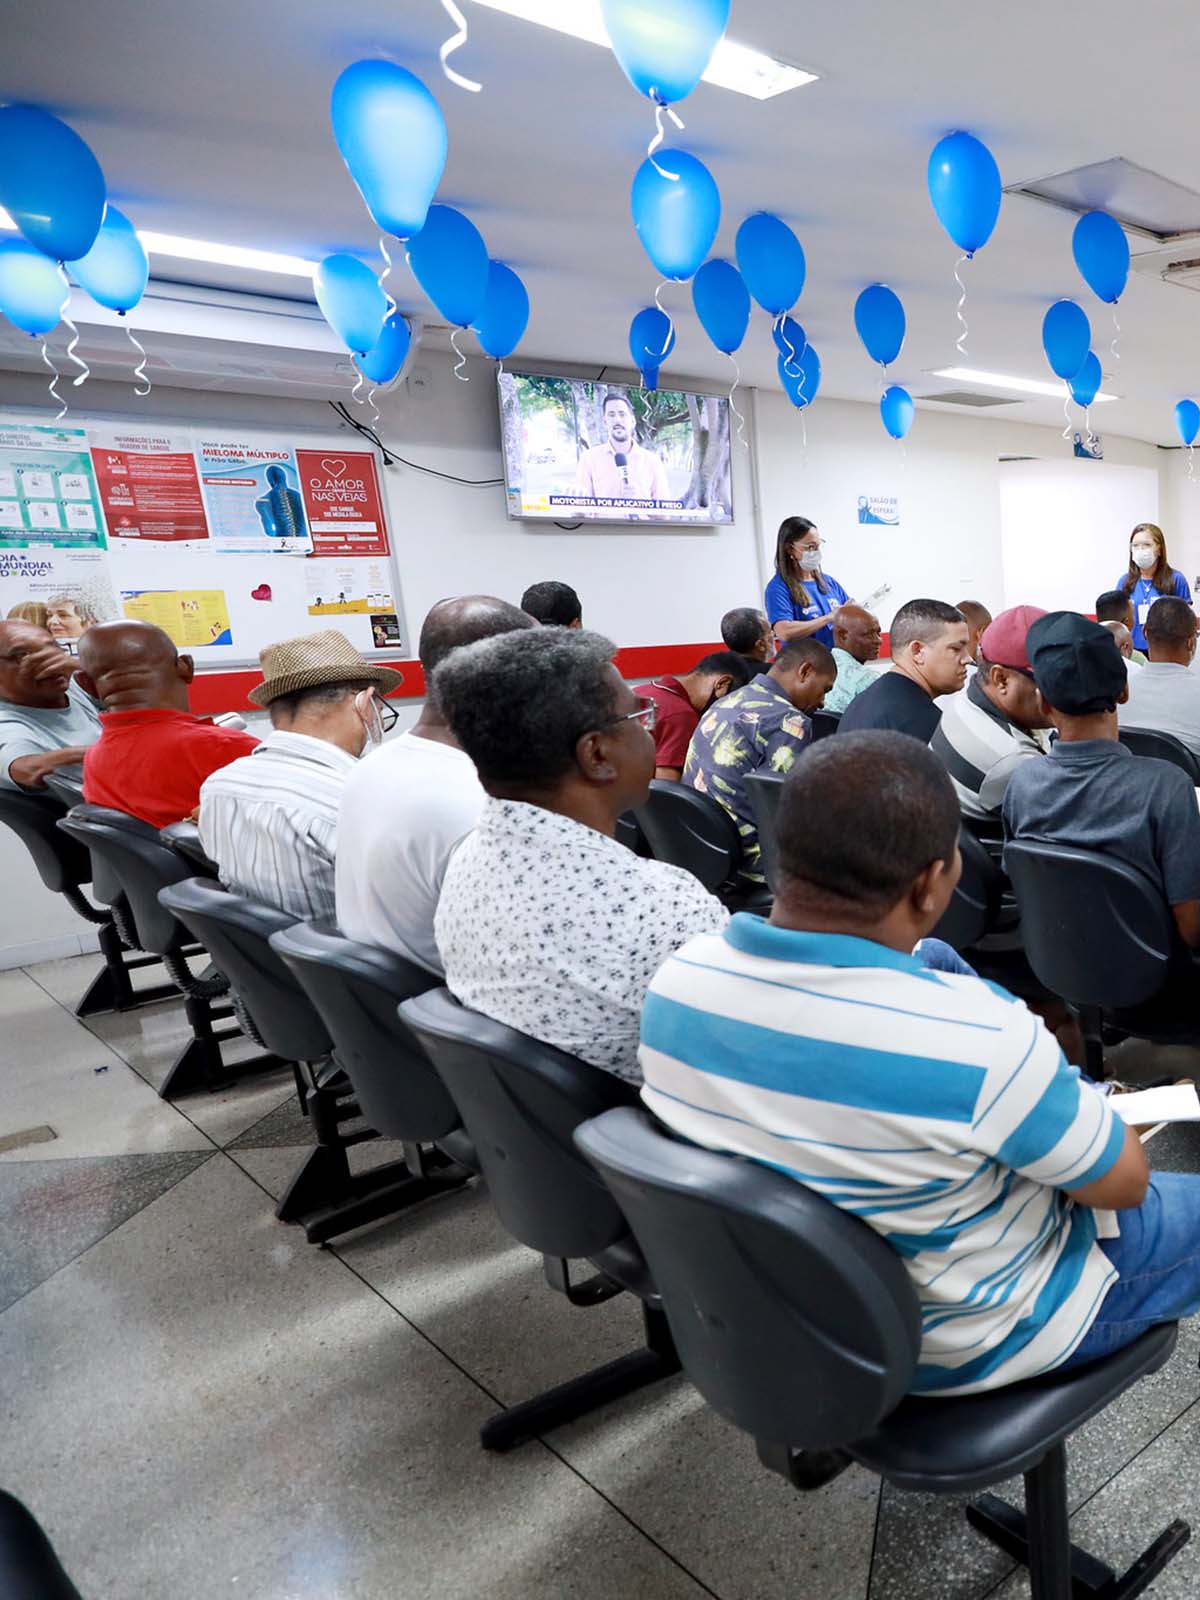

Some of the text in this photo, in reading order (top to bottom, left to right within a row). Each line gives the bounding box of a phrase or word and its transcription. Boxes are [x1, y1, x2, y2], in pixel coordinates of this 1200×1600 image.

[202, 448, 289, 461] MIELOMA MÚLTIPLO
[310, 477, 365, 490] O AMOR
[311, 491, 368, 503] NAS VEIAS
[551, 497, 596, 506] MOTORISTA
[598, 499, 613, 507] POR
[614, 499, 655, 509] APLICATIVO
[0, 554, 18, 562] DIA
[0, 561, 54, 570] MUNDIAL
[20, 569, 48, 577] AVC
